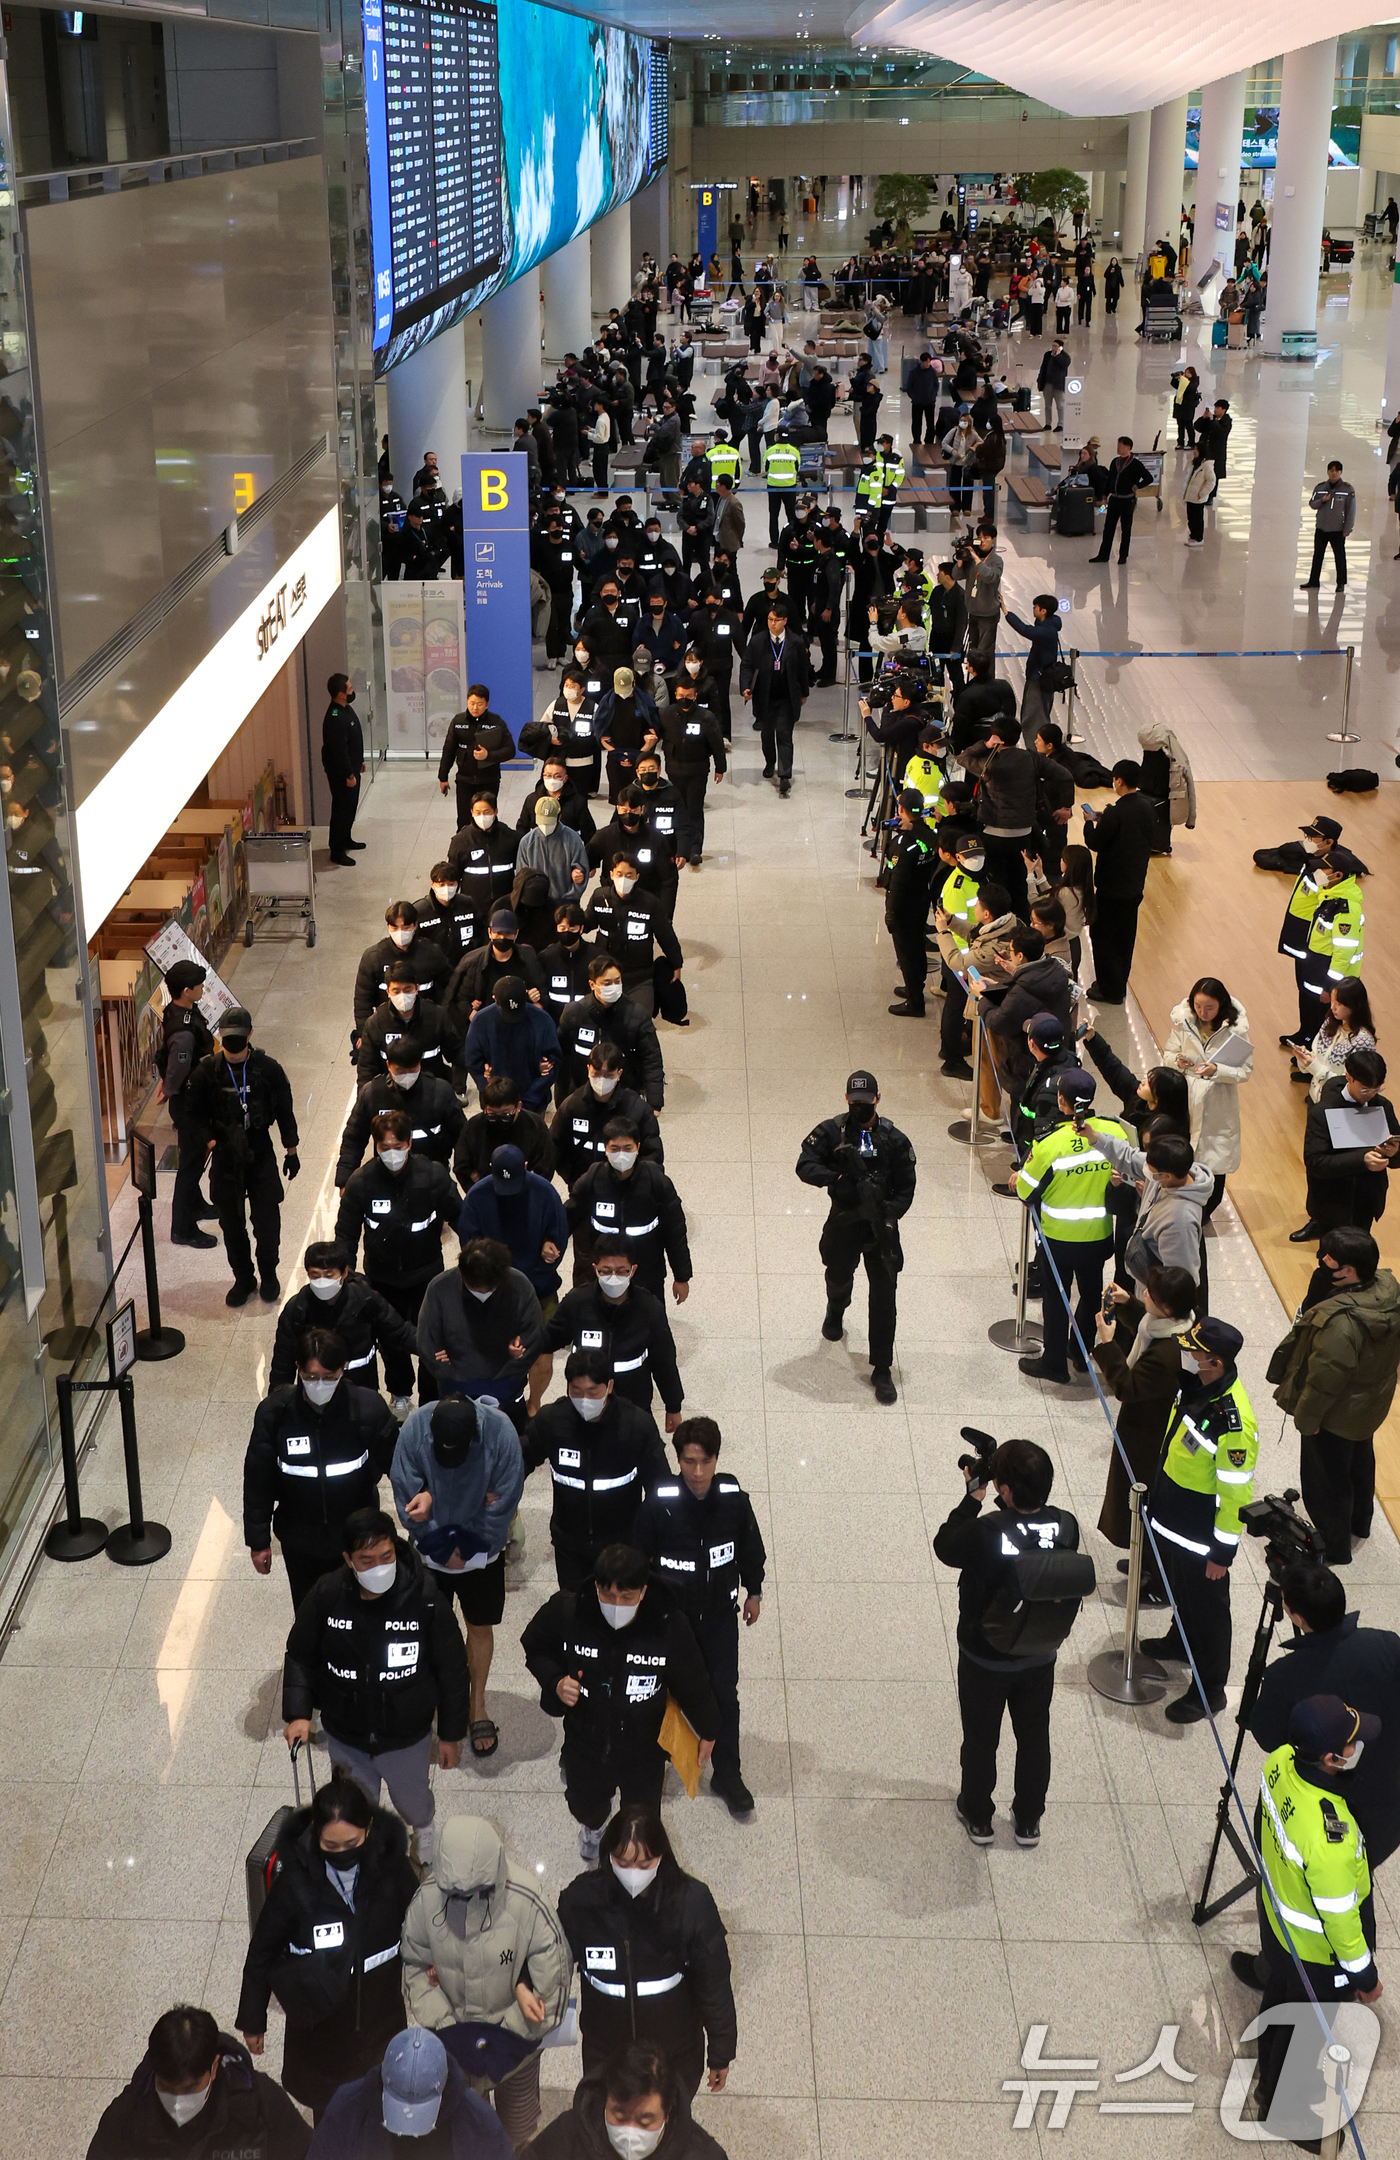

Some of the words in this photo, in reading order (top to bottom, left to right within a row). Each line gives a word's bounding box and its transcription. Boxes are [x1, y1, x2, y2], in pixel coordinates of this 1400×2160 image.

[372, 49, 378, 81] B
[1268, 138, 1278, 148] 중
[702, 191, 712, 206] B
[480, 469, 509, 511] B
[476, 568, 493, 579] 도착
[476, 580, 503, 589] Arrivals
[544, 808, 549, 816] B
[419, 918, 441, 928] POLICE
[454, 913, 474, 922] POLICE
[628, 911, 650, 920] POLICE
[1070, 1137, 1084, 1152] 경
[1066, 1161, 1112, 1177] POLIC
[660, 1556, 696, 1572] POLICE
[385, 1620, 419, 1631] POLIC
[564, 1641, 599, 1658] LICE
[626, 1653, 666, 1666] POLICE
[379, 1664, 417, 1682] POLICE
[499, 1949, 513, 1965] NY
[211, 2148, 261, 2160] POLICE
